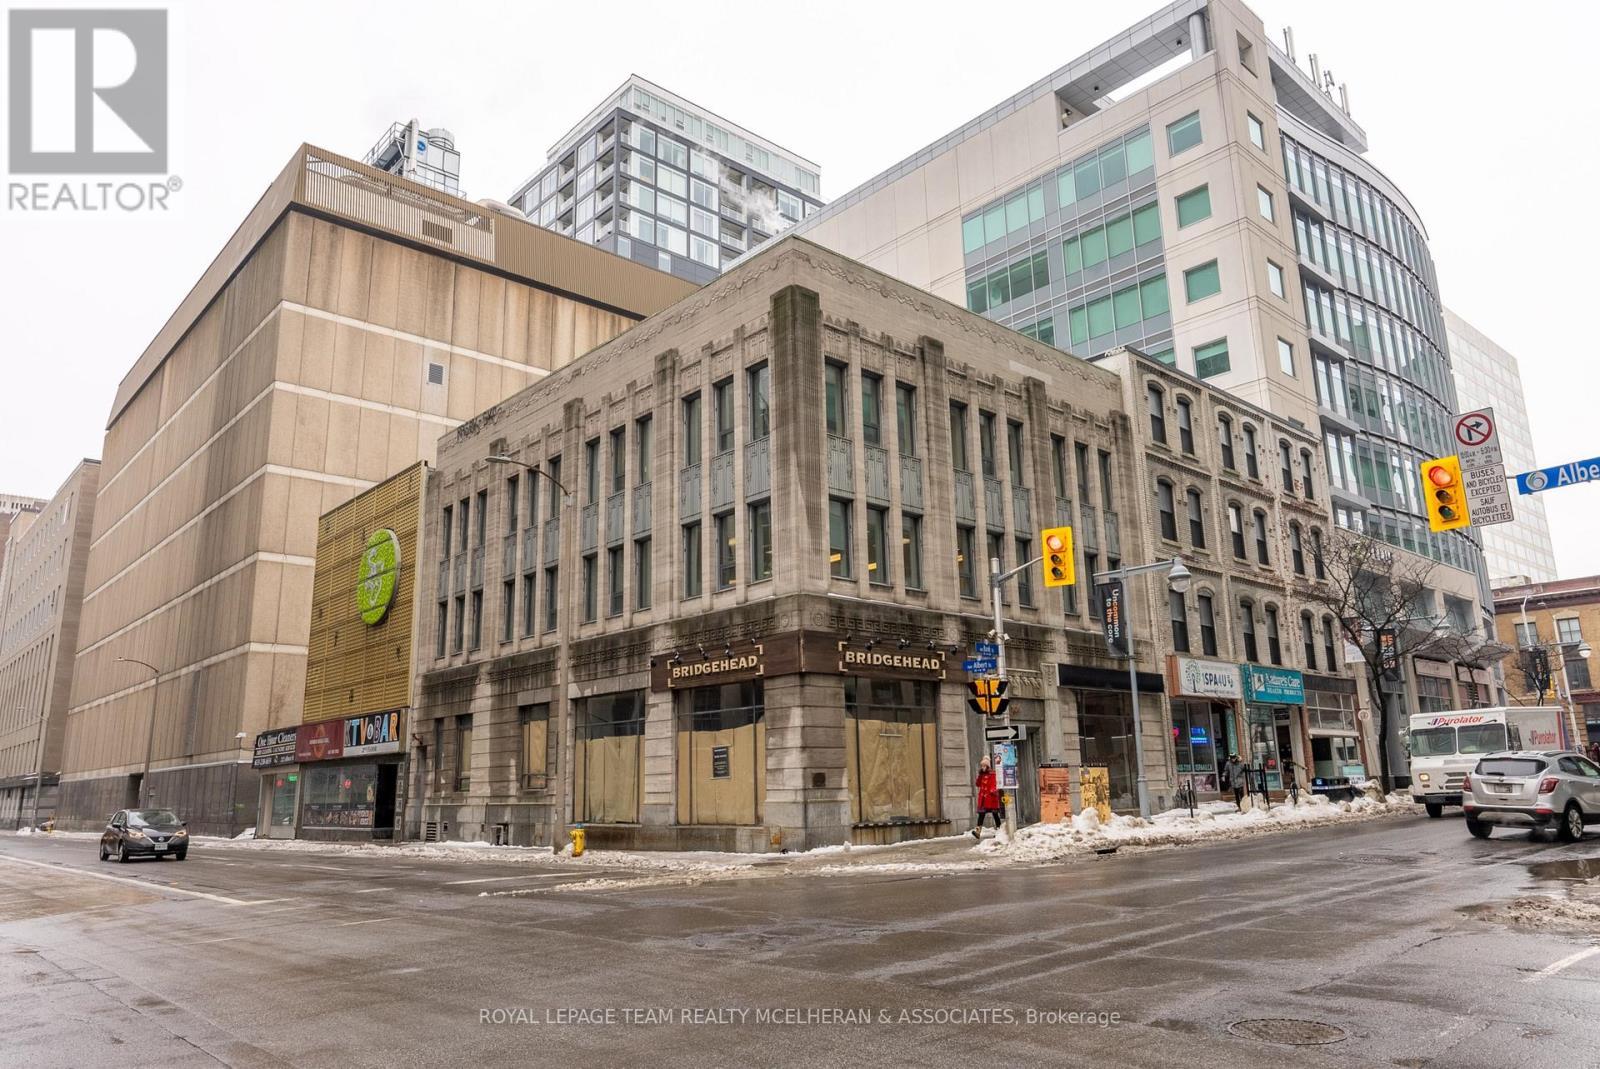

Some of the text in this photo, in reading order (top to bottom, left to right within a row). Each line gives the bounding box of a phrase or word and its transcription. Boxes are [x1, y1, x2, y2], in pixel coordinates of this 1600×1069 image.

[1470, 468, 1495, 479] BUSES
[1466, 475, 1503, 488] AND BICYCLES
[1471, 485, 1501, 496] EXCEPTED
[1480, 497, 1495, 505] SAUF
[1471, 503, 1508, 516] AUTOBUS ET
[1472, 512, 1511, 525] BICYCLETTES
[1112, 589, 1120, 638] Uncommon
[672, 655, 758, 678] BRIDGEHEAD
[845, 651, 940, 670] BRIDGEHEAD
[1437, 716, 1484, 725] Purolator
[373, 712, 398, 744] BAR
